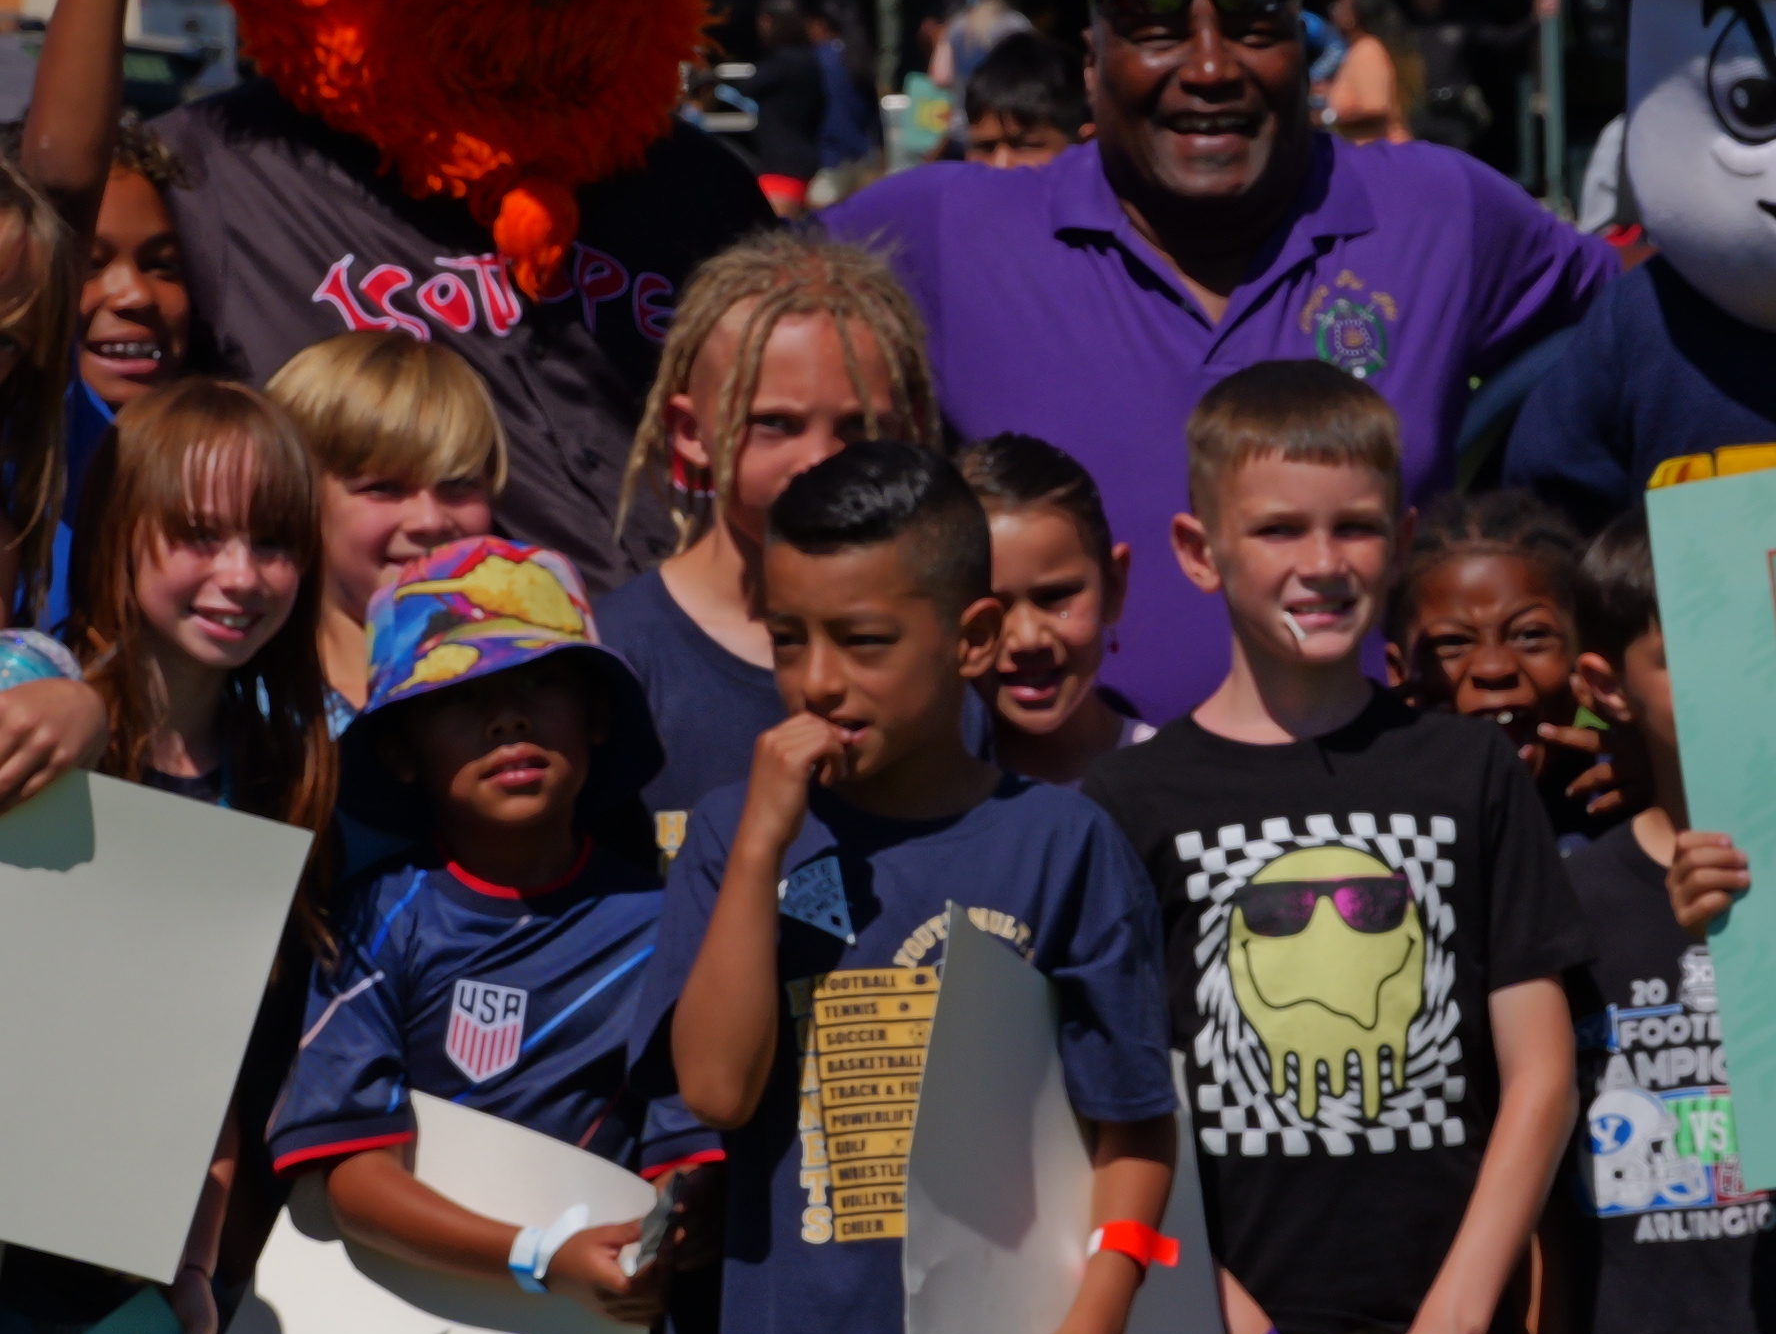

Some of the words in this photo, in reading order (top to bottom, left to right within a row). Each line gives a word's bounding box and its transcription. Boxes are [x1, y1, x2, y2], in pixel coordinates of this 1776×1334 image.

[458, 984, 521, 1025] USA
[824, 1001, 879, 1018] TENNIS
[825, 1028, 887, 1046] SOCCER
[829, 1083, 879, 1100] TRACK
[1689, 1110, 1728, 1154] VS
[835, 1138, 867, 1155] GOLF
[842, 1218, 884, 1236] CHEER
